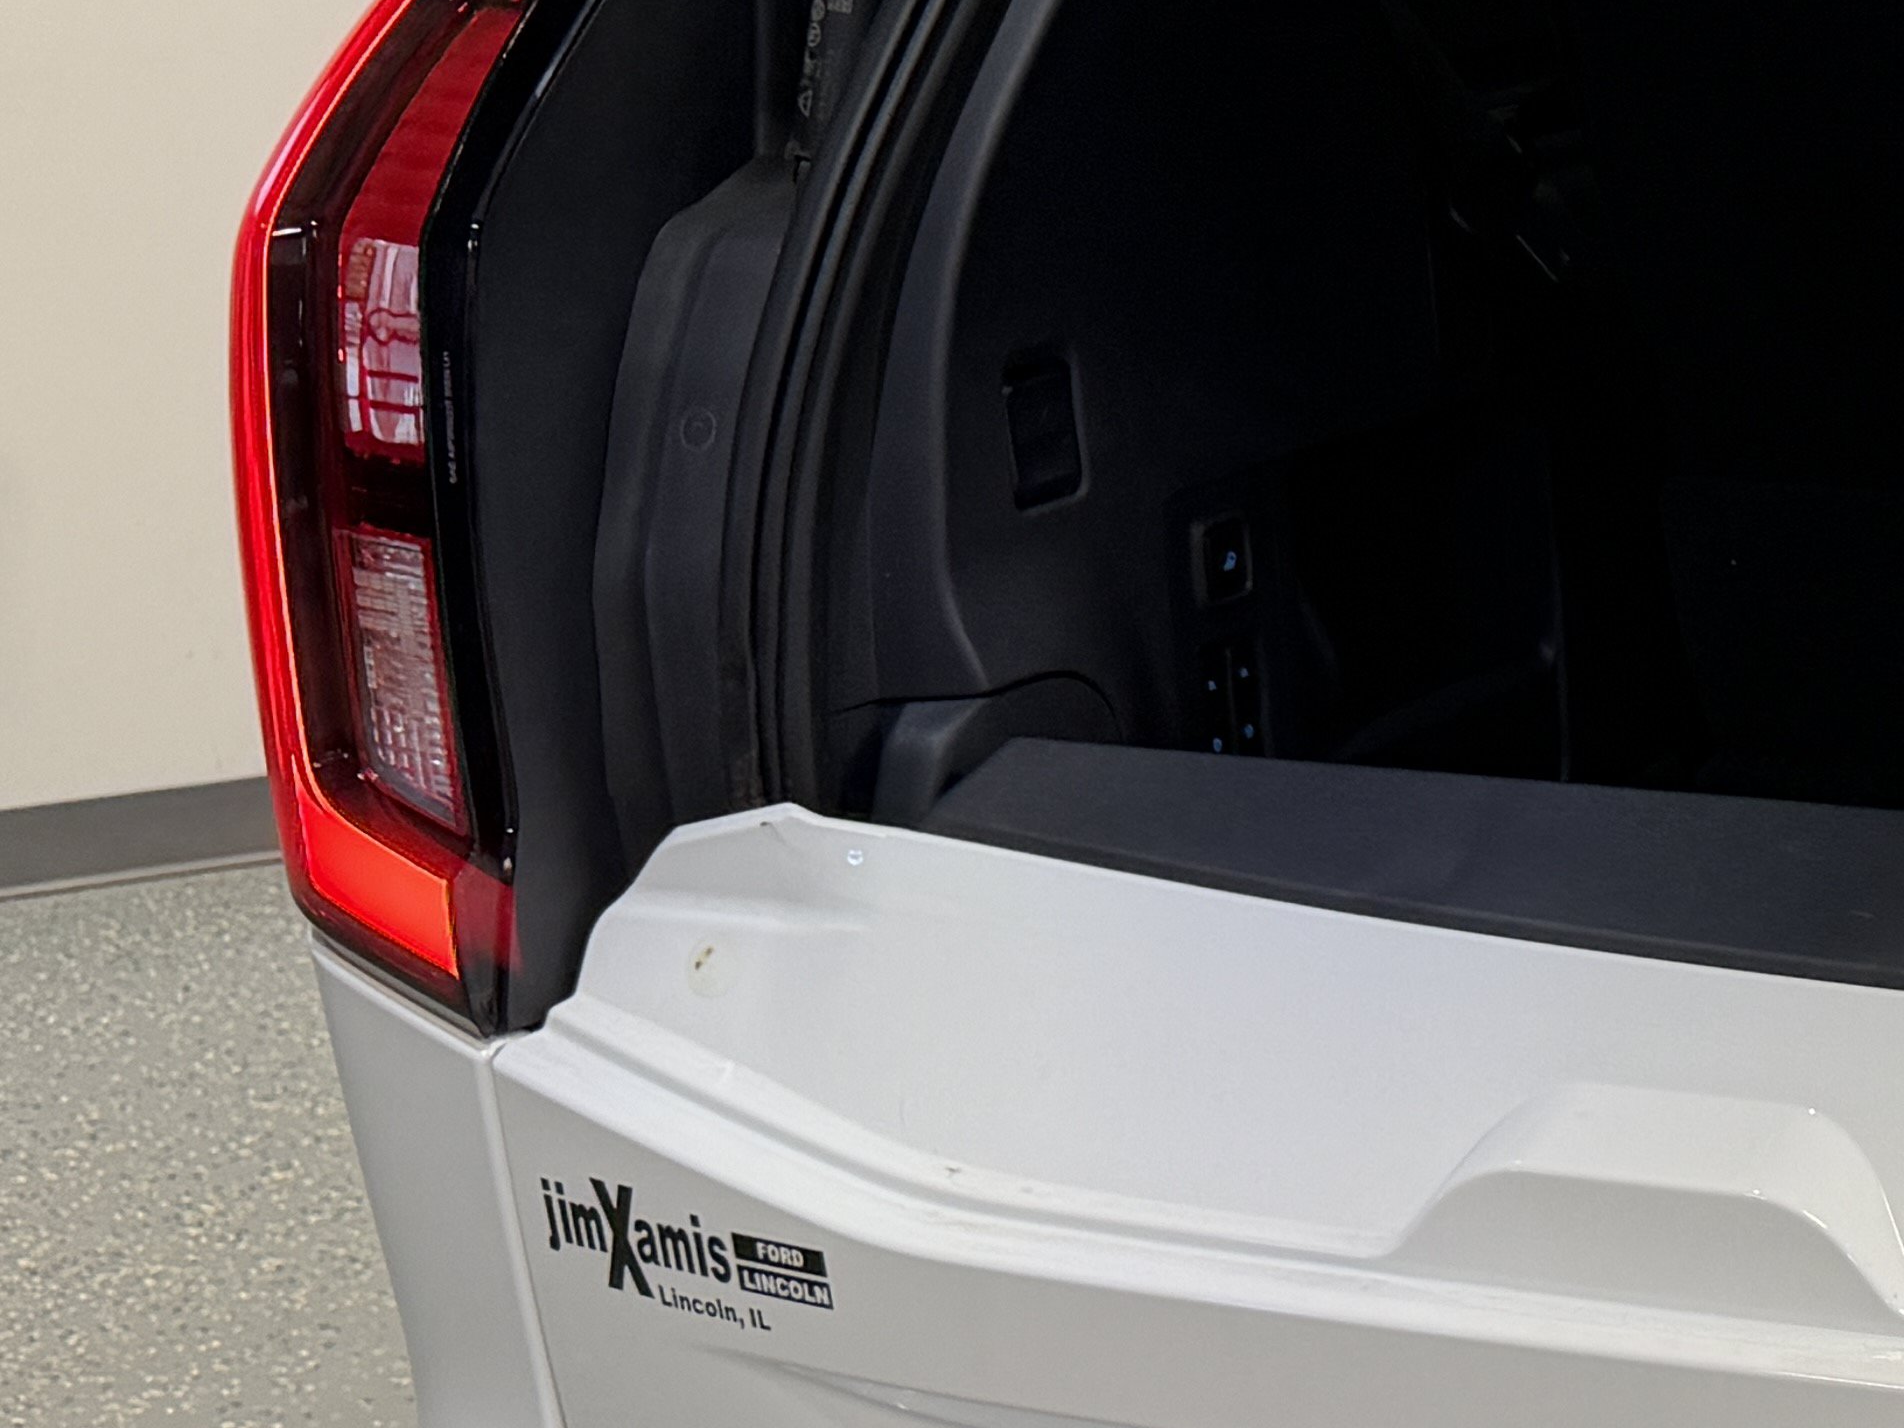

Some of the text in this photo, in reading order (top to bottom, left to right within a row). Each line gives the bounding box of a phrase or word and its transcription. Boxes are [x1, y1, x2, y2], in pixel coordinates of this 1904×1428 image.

[755, 1241, 805, 1268] FORD
[742, 1268, 831, 1306] LINCOLN
[658, 1284, 772, 1332] Lincoln, IL
